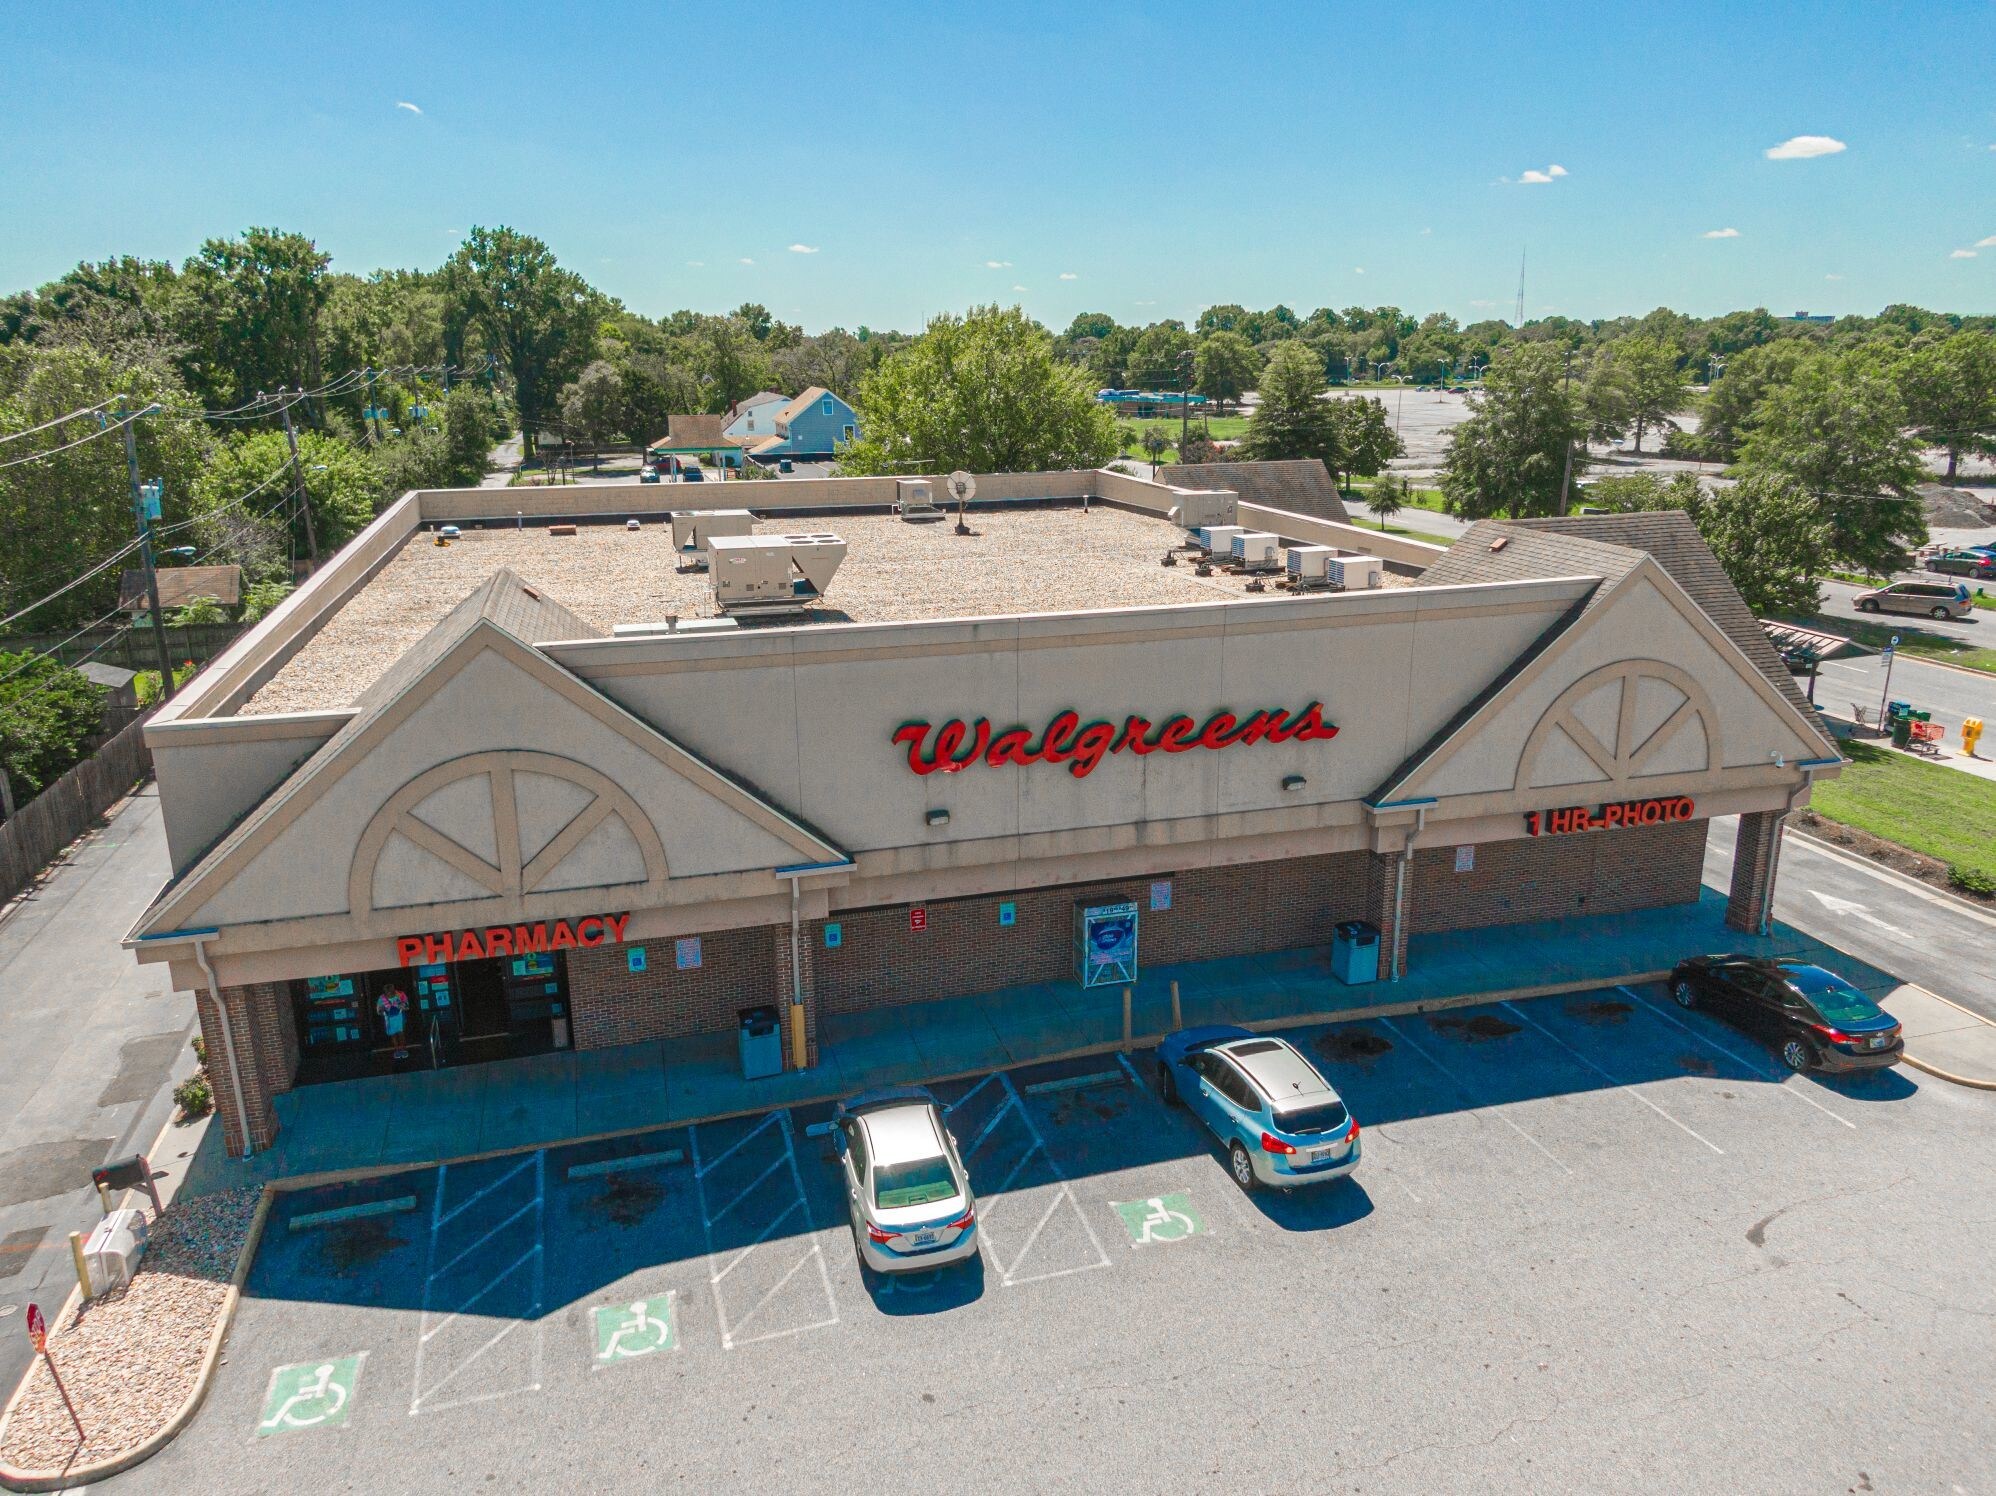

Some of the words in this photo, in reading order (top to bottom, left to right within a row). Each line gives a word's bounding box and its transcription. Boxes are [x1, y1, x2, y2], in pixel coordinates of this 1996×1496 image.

[891, 700, 1340, 778] Walgreens
[1526, 811, 1541, 837] 1
[1549, 796, 1694, 834] HR-PHOTO
[396, 912, 631, 967] PHARMACY
